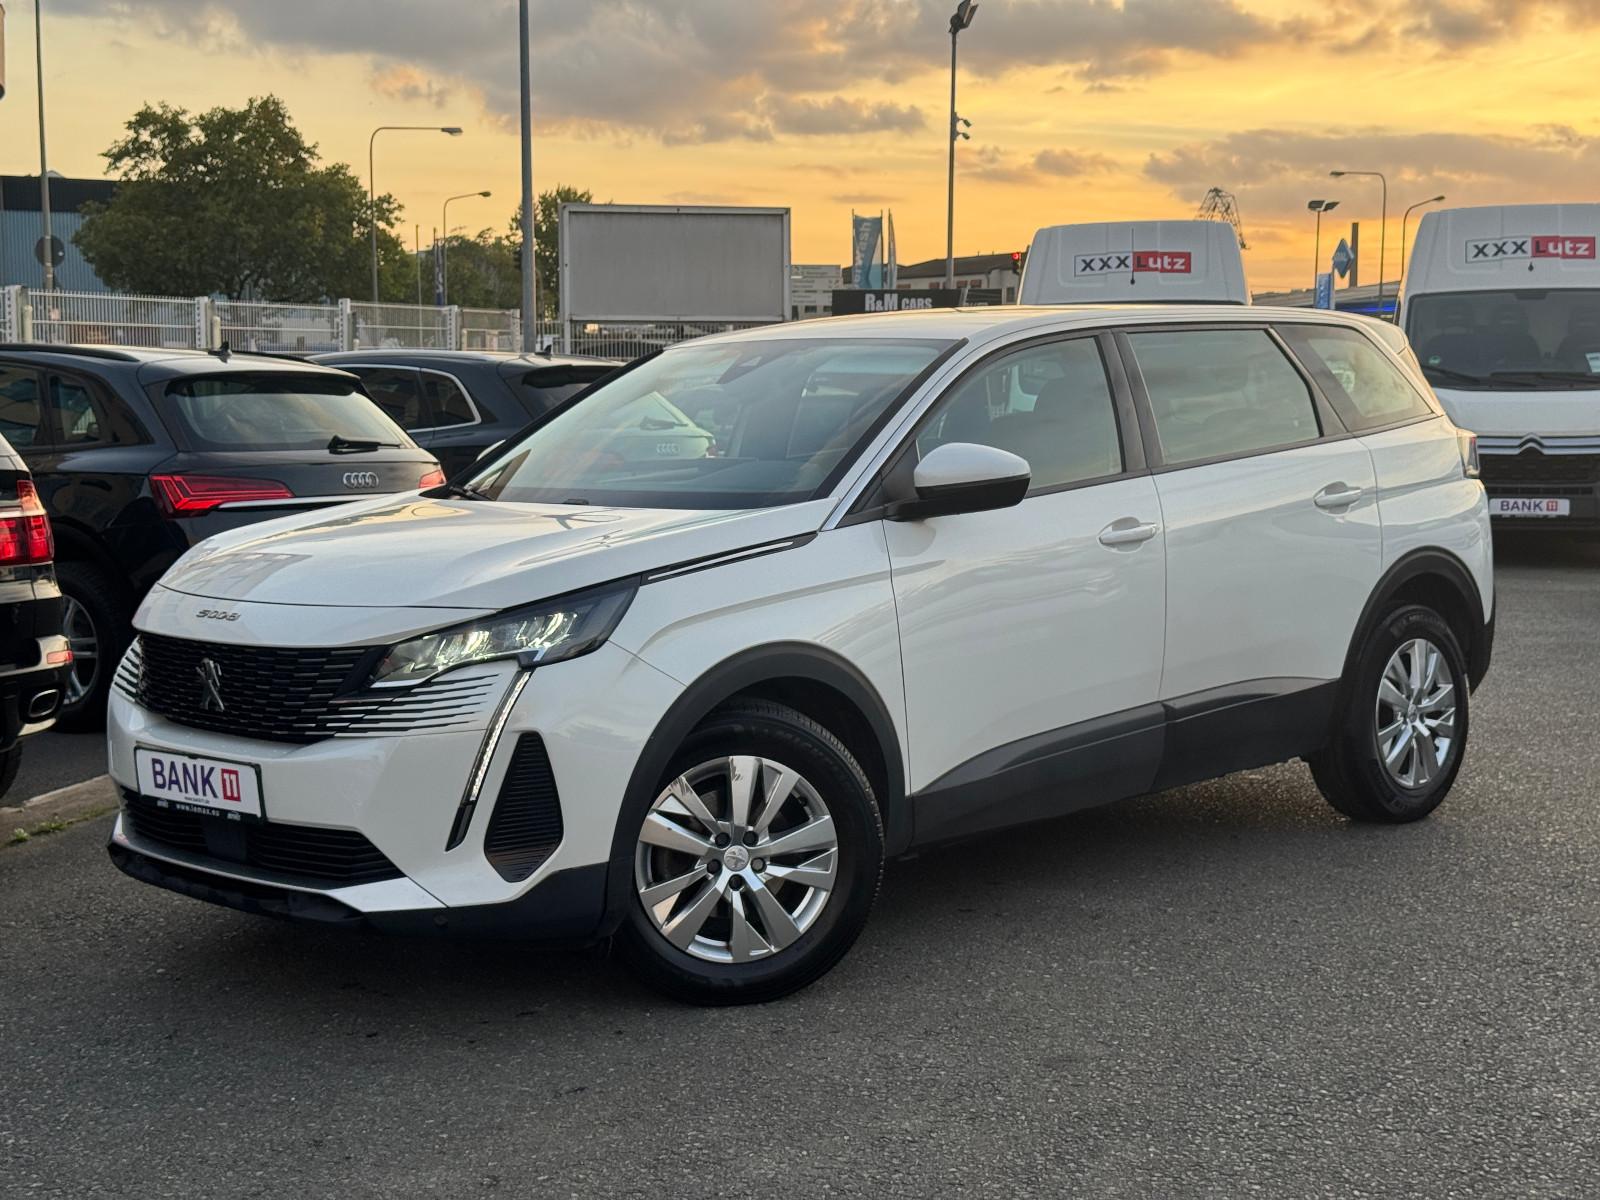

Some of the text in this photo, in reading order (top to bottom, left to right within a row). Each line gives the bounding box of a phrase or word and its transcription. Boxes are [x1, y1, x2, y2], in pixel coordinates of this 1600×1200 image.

[1472, 239, 1590, 259] XXXLutz
[1080, 255, 1186, 272] XXXLutz
[864, 293, 932, 312] R&M CARS
[1500, 500, 1543, 512] BANK
[151, 757, 218, 799] BANK
